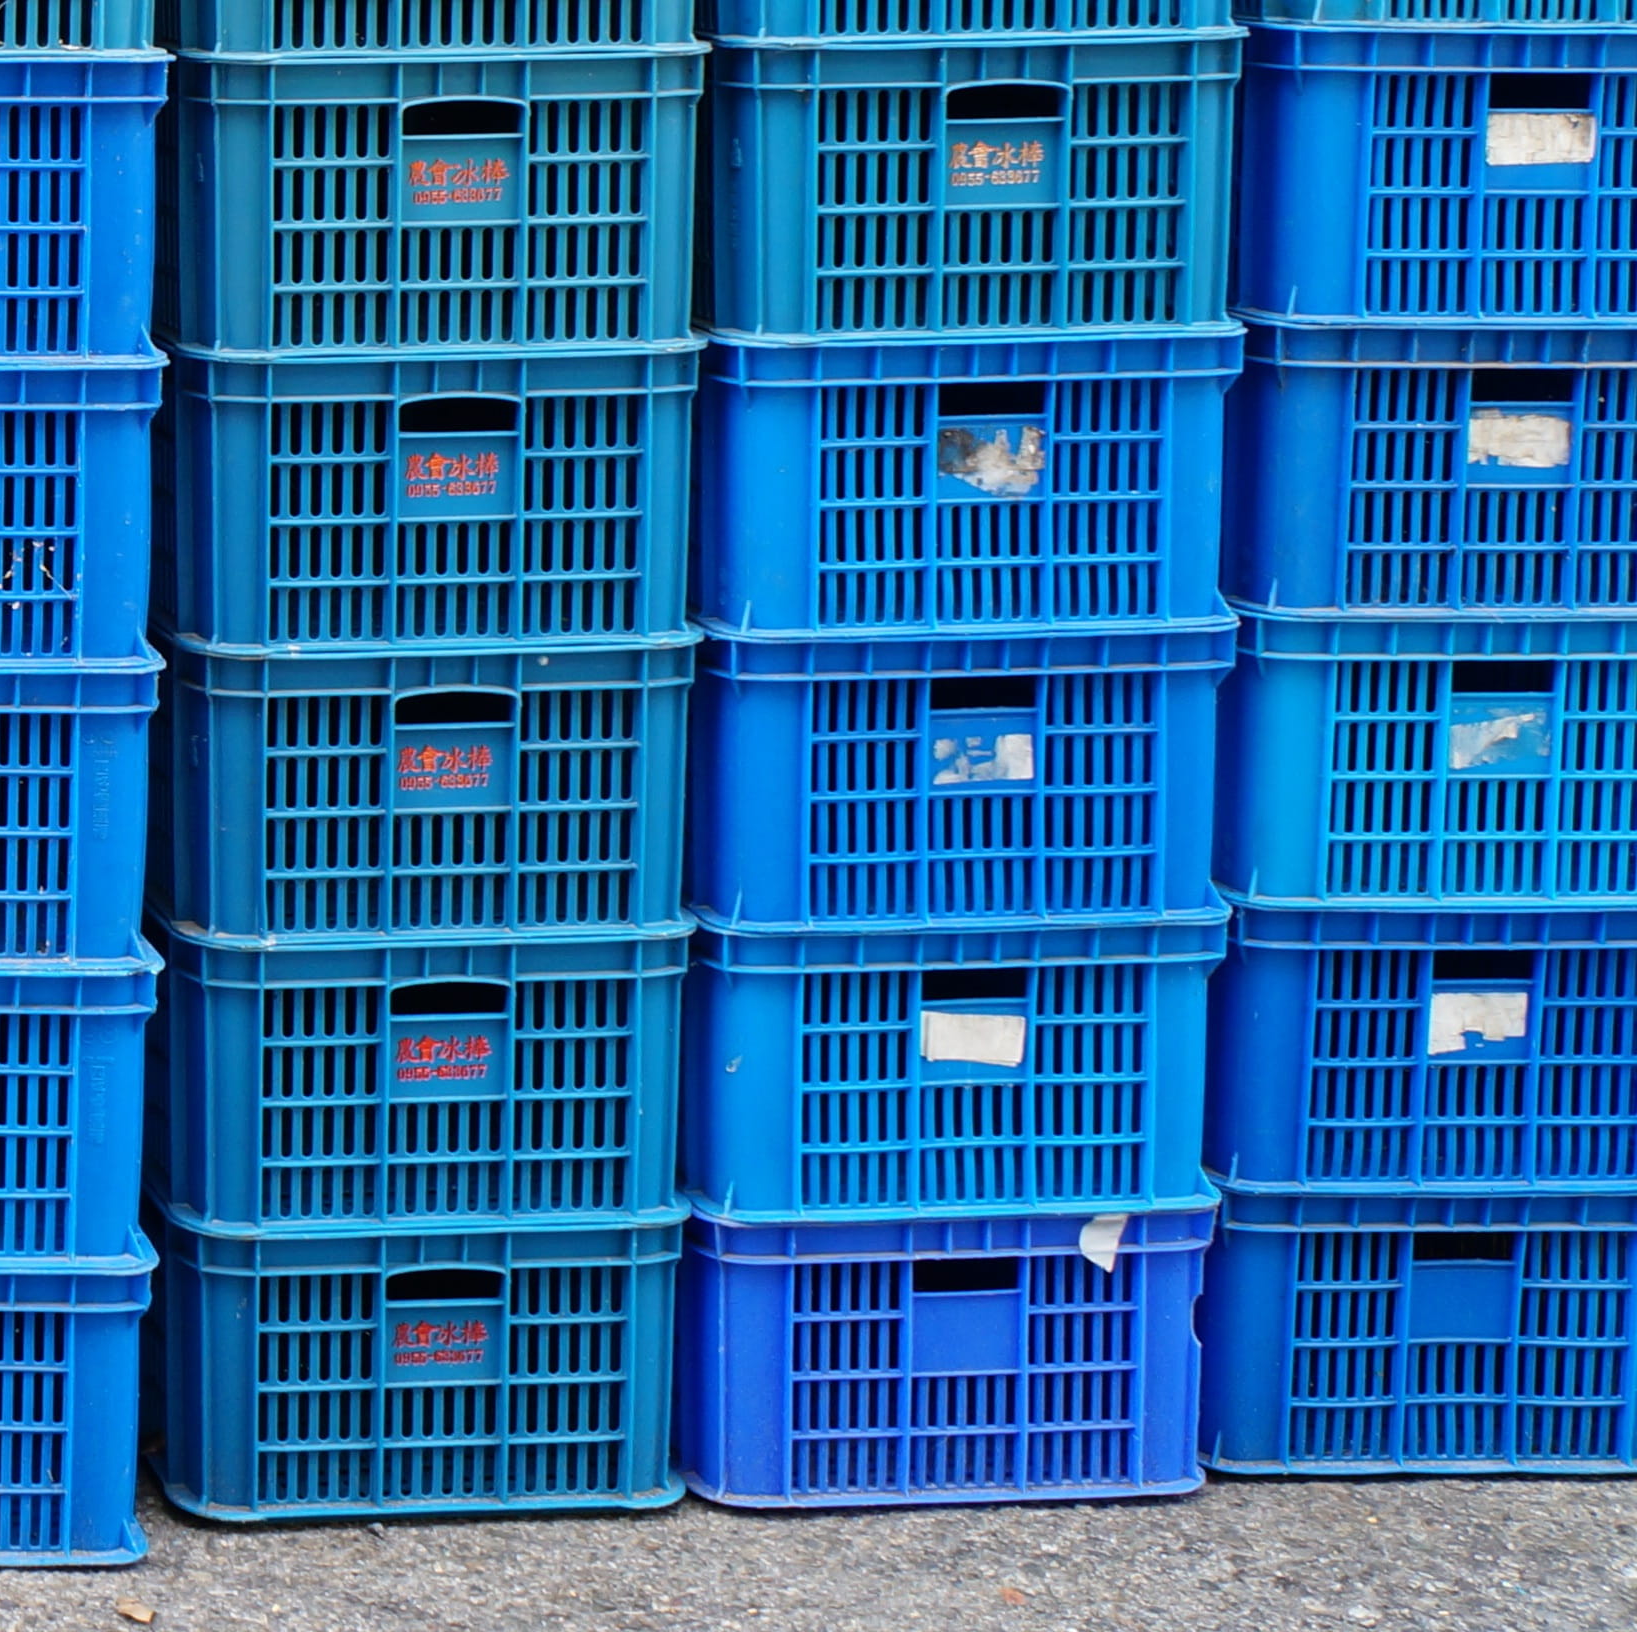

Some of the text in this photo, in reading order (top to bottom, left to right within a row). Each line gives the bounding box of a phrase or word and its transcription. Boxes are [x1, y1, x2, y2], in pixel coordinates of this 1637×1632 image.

[949, 141, 1044, 168] 農會冰棒
[409, 158, 510, 186] 農會冰棒
[406, 452, 499, 480] 農會冰棒
[398, 745, 493, 772] 農會冰棒
[397, 1036, 493, 1063] 農會冰棒
[394, 1321, 489, 1348] 農會冰棒
